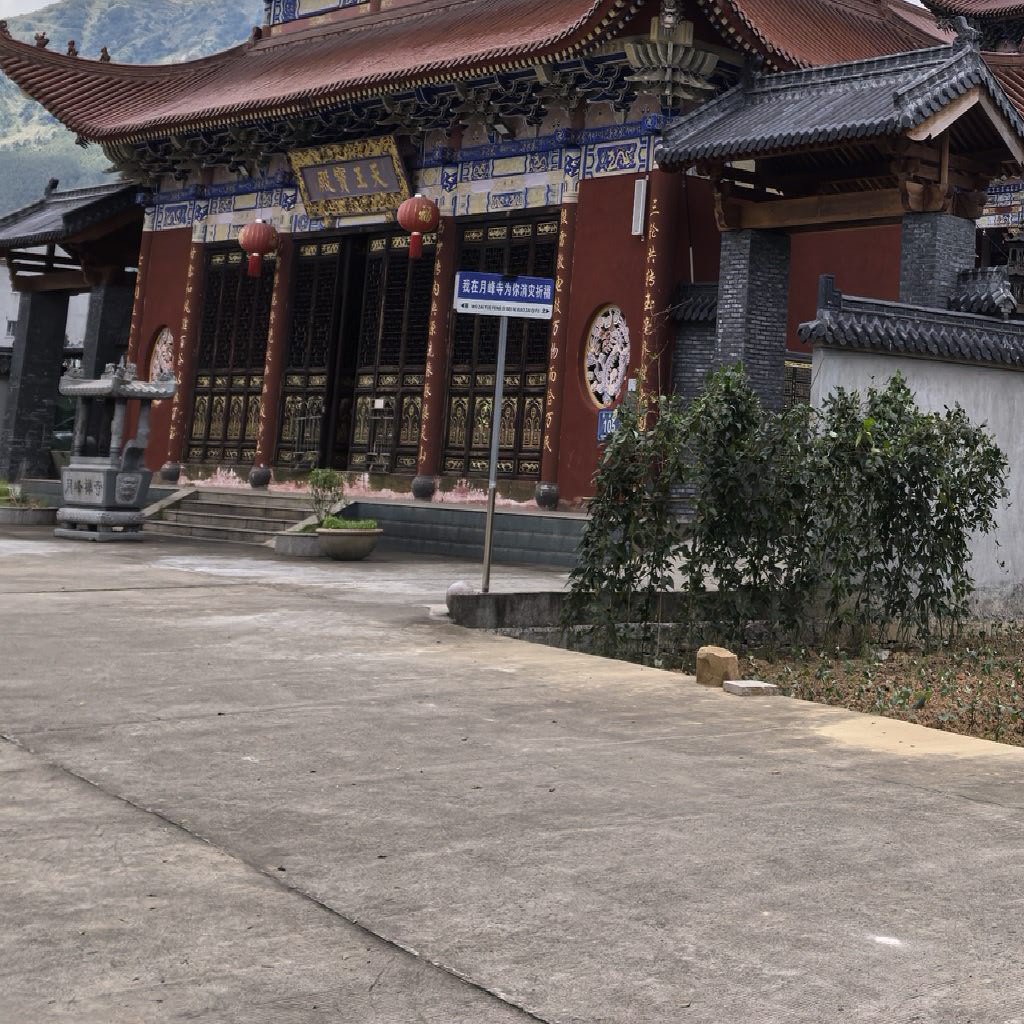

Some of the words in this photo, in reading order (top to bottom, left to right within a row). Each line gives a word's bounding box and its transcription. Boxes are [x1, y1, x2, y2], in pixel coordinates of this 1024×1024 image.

[462, 279, 551, 300] 我在月峰寺为你消灾祈福
[603, 420, 615, 433] 105
